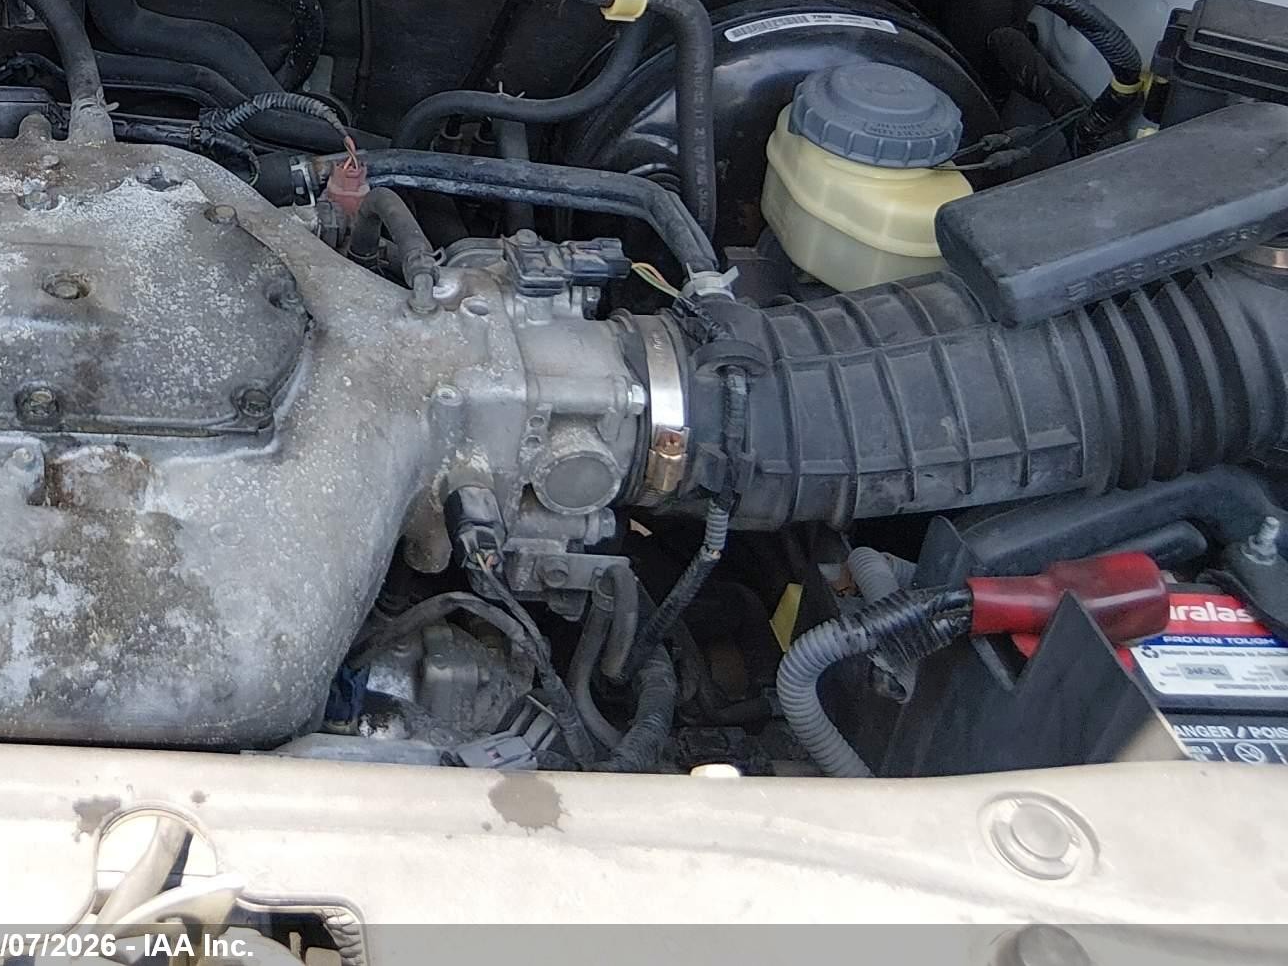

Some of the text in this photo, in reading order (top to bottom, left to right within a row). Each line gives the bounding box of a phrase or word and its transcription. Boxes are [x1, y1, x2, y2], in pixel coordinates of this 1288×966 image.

[1170, 601, 1255, 624] ralas
[1162, 635, 1276, 646] PROVEN TOUGH
[1172, 724, 1236, 739] ANGER
[1247, 726, 1288, 740] POIS
